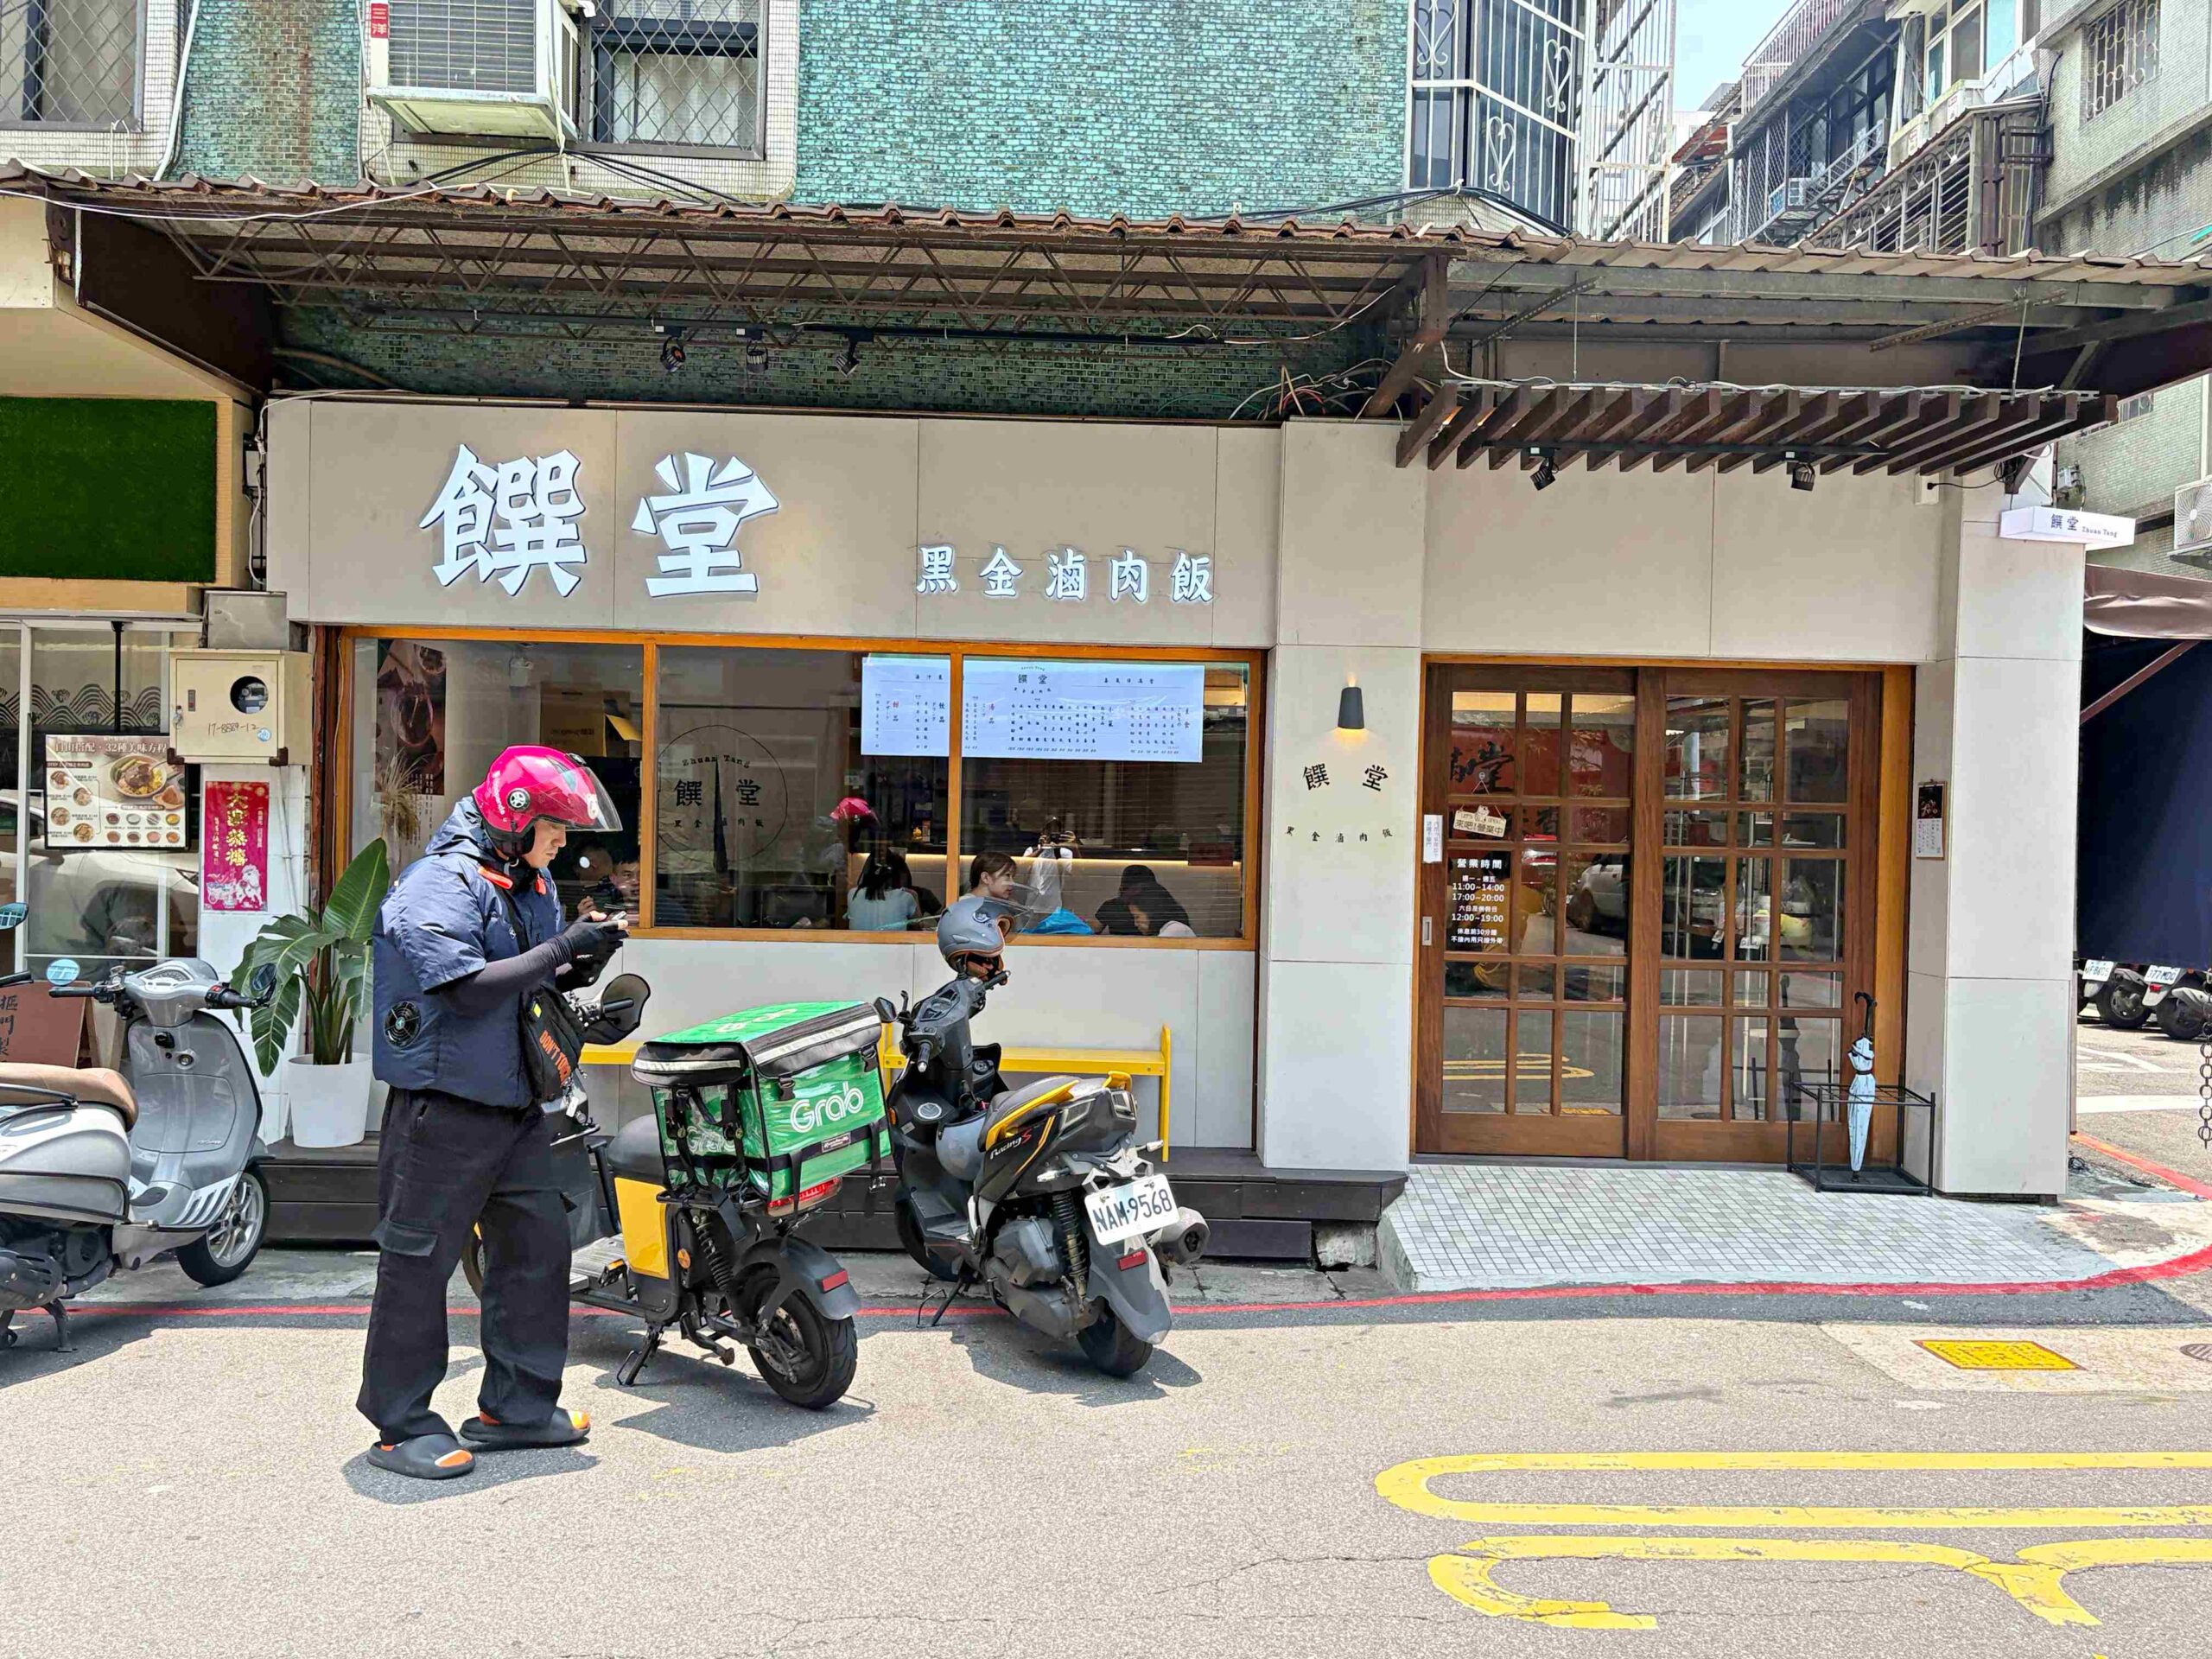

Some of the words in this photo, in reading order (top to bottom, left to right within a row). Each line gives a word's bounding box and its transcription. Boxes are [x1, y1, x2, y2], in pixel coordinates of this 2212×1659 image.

[372, 8, 387, 35] 三洋
[418, 443, 779, 598] 饌堂
[2050, 513, 2079, 531] 饌堂
[2103, 529, 2118, 537] Tang
[916, 546, 1213, 603] 黑金滷肉飯
[723, 754, 750, 768] Tang
[1302, 763, 1389, 791] 饌堂
[673, 779, 761, 807] 饌堂
[1457, 858, 1503, 870] 營業時間
[1452, 882, 1505, 892] 11:00~14:00
[1452, 893, 1504, 902] 17:00~20:00
[1451, 913, 1503, 923] 12:00~19:00
[790, 1081, 864, 1134] Grab
[989, 1136, 1022, 1160] Racing
